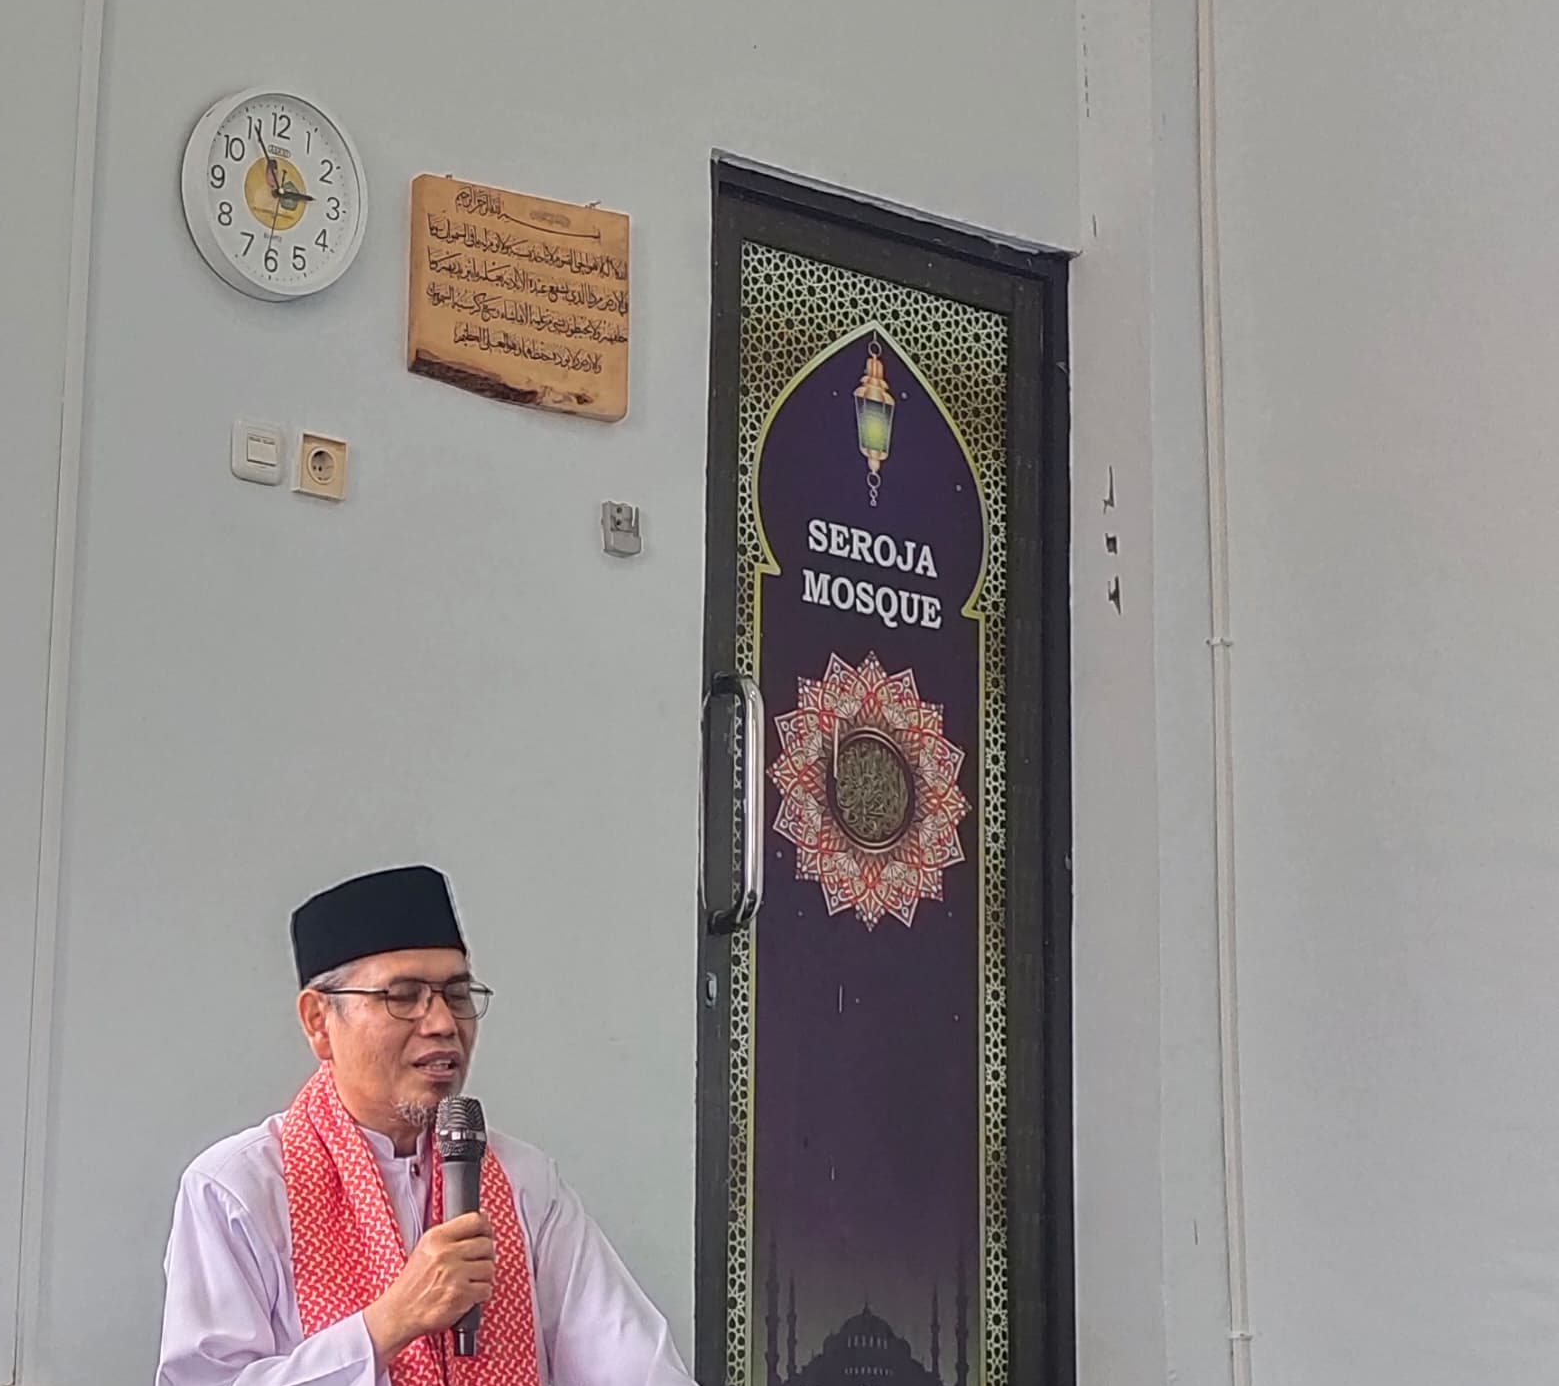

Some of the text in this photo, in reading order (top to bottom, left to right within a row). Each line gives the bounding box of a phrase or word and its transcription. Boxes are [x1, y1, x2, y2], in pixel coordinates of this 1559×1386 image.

[247, 116, 263, 142] 11
[272, 113, 292, 140] 12
[224, 134, 245, 161] 10
[306, 131, 312, 154] 1
[210, 165, 226, 189] 9
[319, 159, 333, 184] 2
[218, 202, 233, 226] 8
[326, 197, 340, 221] 3
[240, 231, 255, 256] 7
[314, 229, 328, 252] 4
[264, 248, 278, 272] 6
[292, 246, 306, 271] 5
[808, 519, 938, 578] SEROJA
[802, 569, 942, 630] MOSQUE
